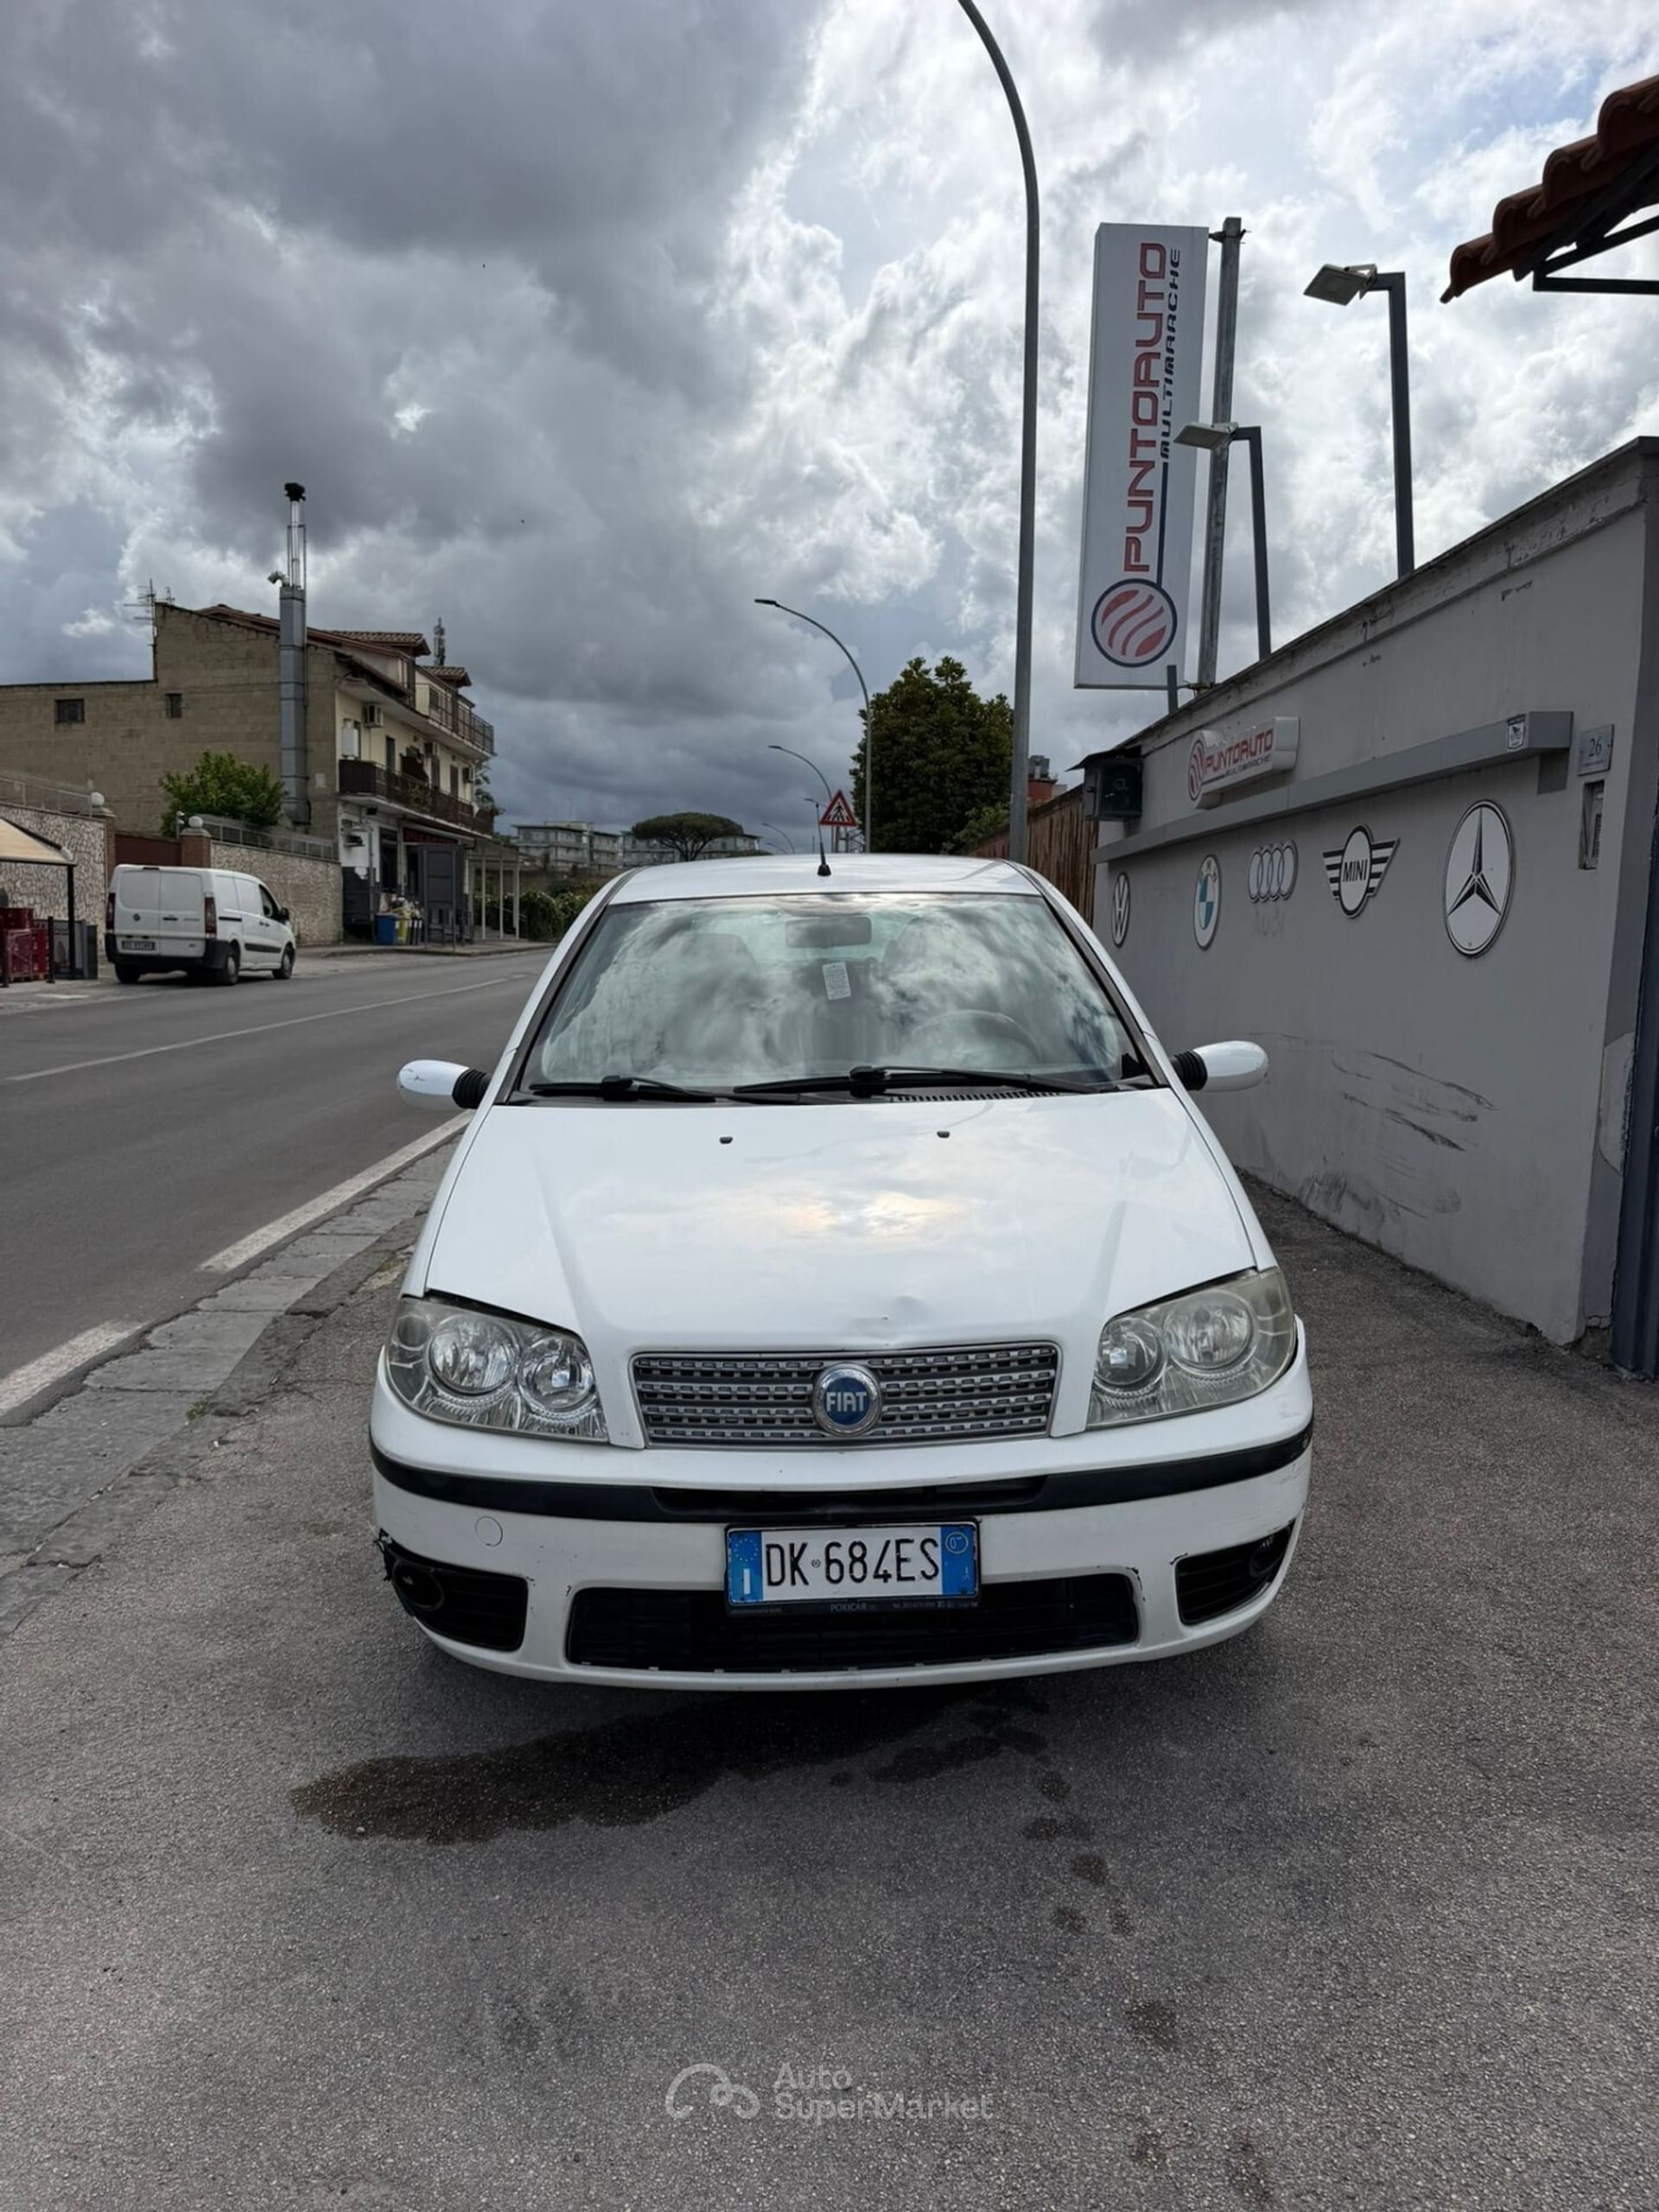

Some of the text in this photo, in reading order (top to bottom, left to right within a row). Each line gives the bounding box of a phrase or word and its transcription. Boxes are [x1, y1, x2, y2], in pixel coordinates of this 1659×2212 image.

[1160, 248, 1180, 459] MULTIMARCHE
[1123, 243, 1166, 572] PUNTOAUTO
[1202, 728, 1273, 773] PUNTOAUTO
[1588, 736, 1602, 757] 26
[1343, 859, 1368, 882] MINI
[826, 1391, 867, 1412] FIAT
[743, 1568, 750, 1594] I
[766, 1542, 809, 1586] DK
[825, 1538, 938, 1584] 684ES
